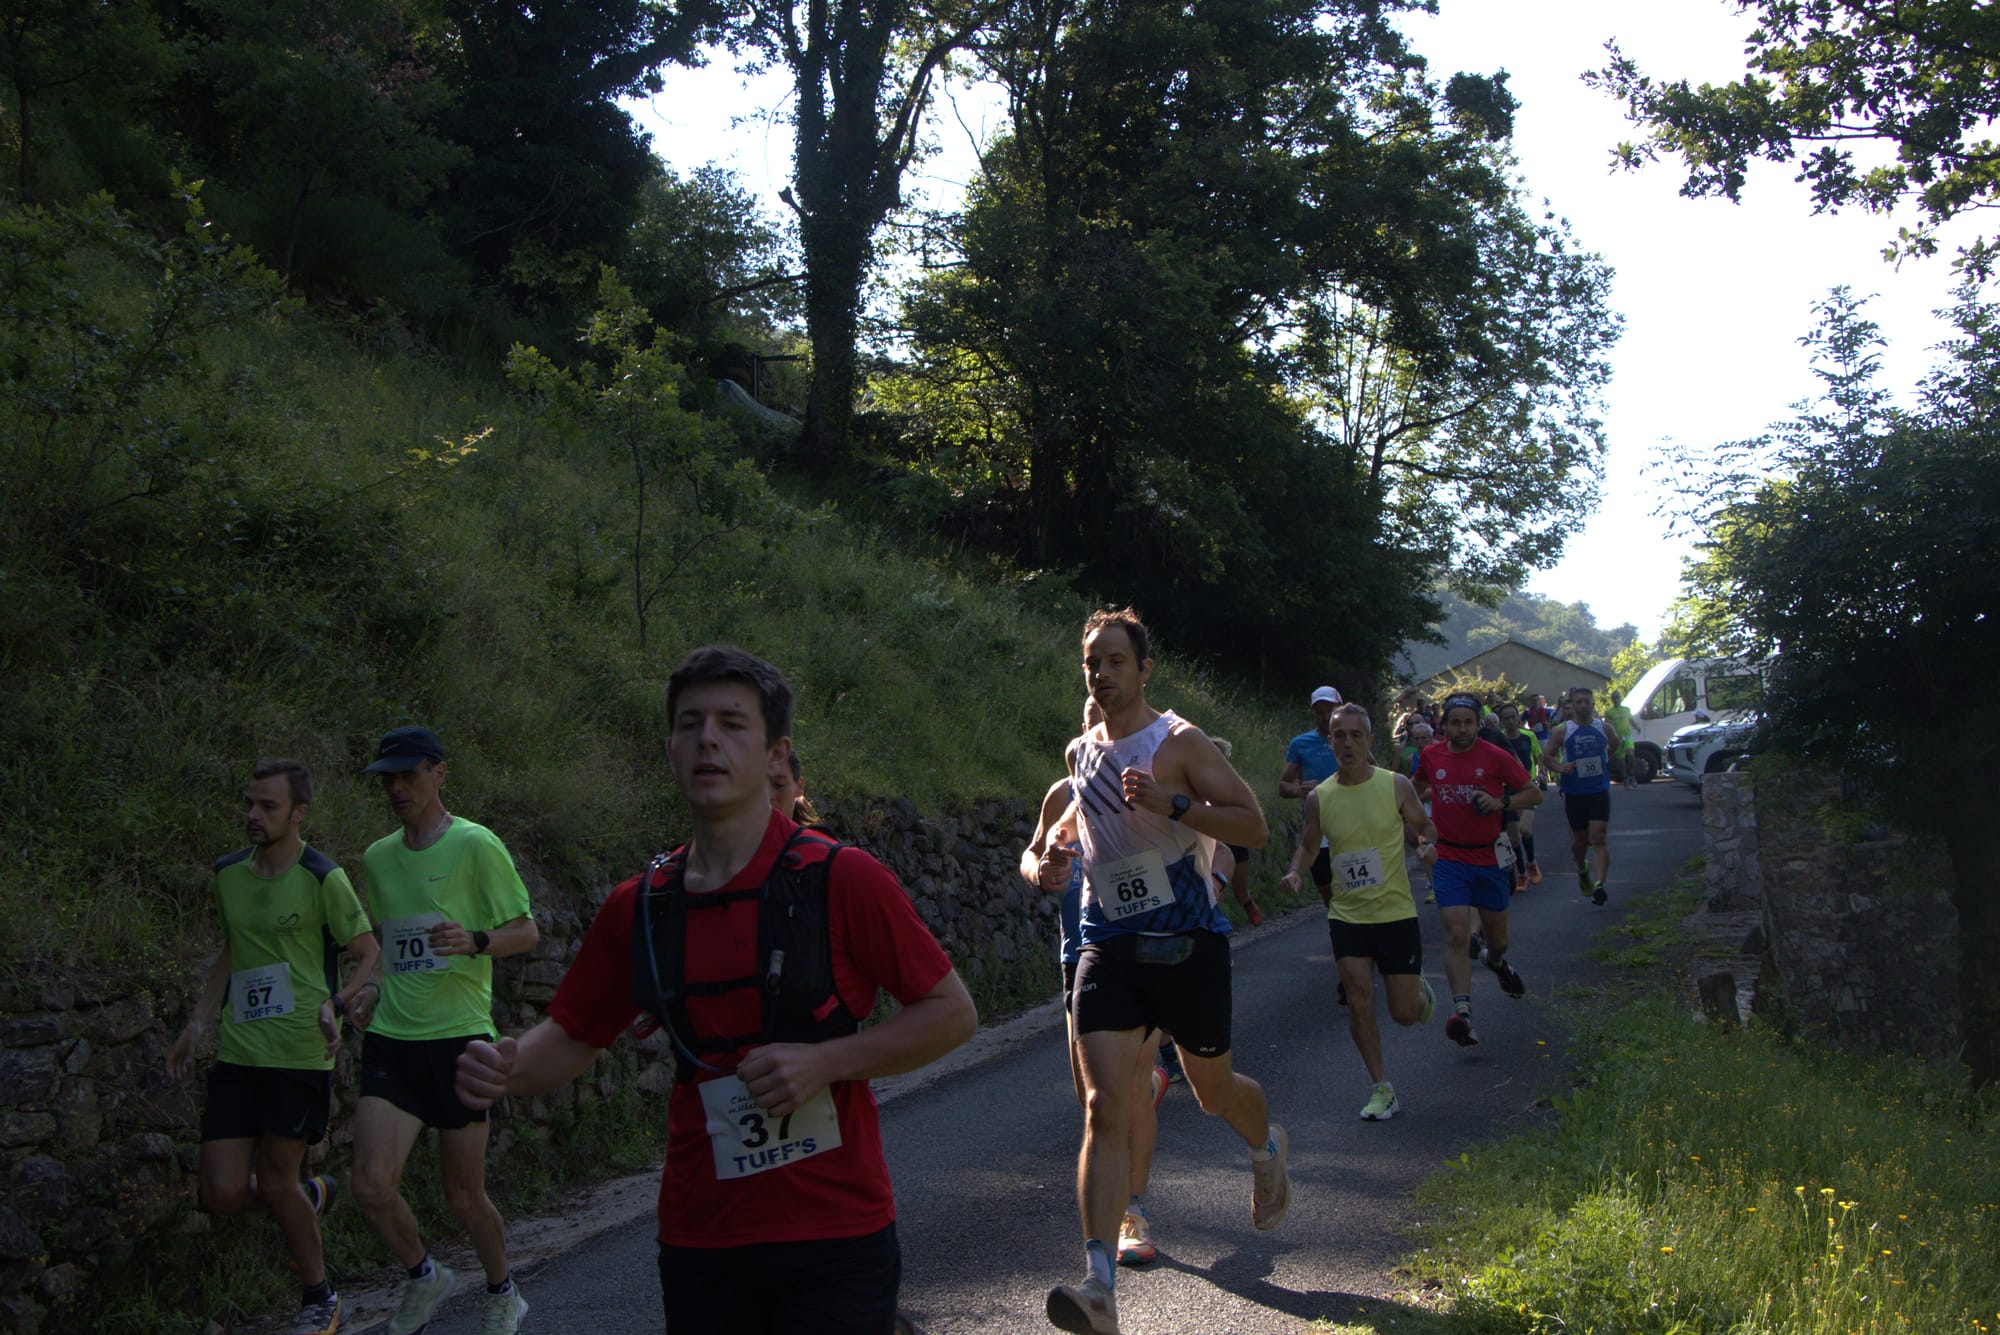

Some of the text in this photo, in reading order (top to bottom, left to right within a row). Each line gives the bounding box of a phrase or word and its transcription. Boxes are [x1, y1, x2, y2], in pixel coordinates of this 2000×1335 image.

[1347, 865, 1369, 880] 14
[1118, 878, 1148, 902] 68
[1346, 878, 1376, 888] TUFF'S
[1114, 896, 1160, 916] TUFF'S
[396, 938, 423, 959] 70
[393, 959, 434, 972] TUFF'S
[248, 986, 272, 1006] 67
[244, 1004, 283, 1019] TUFF'S
[733, 1138, 817, 1172] TUFF'S
